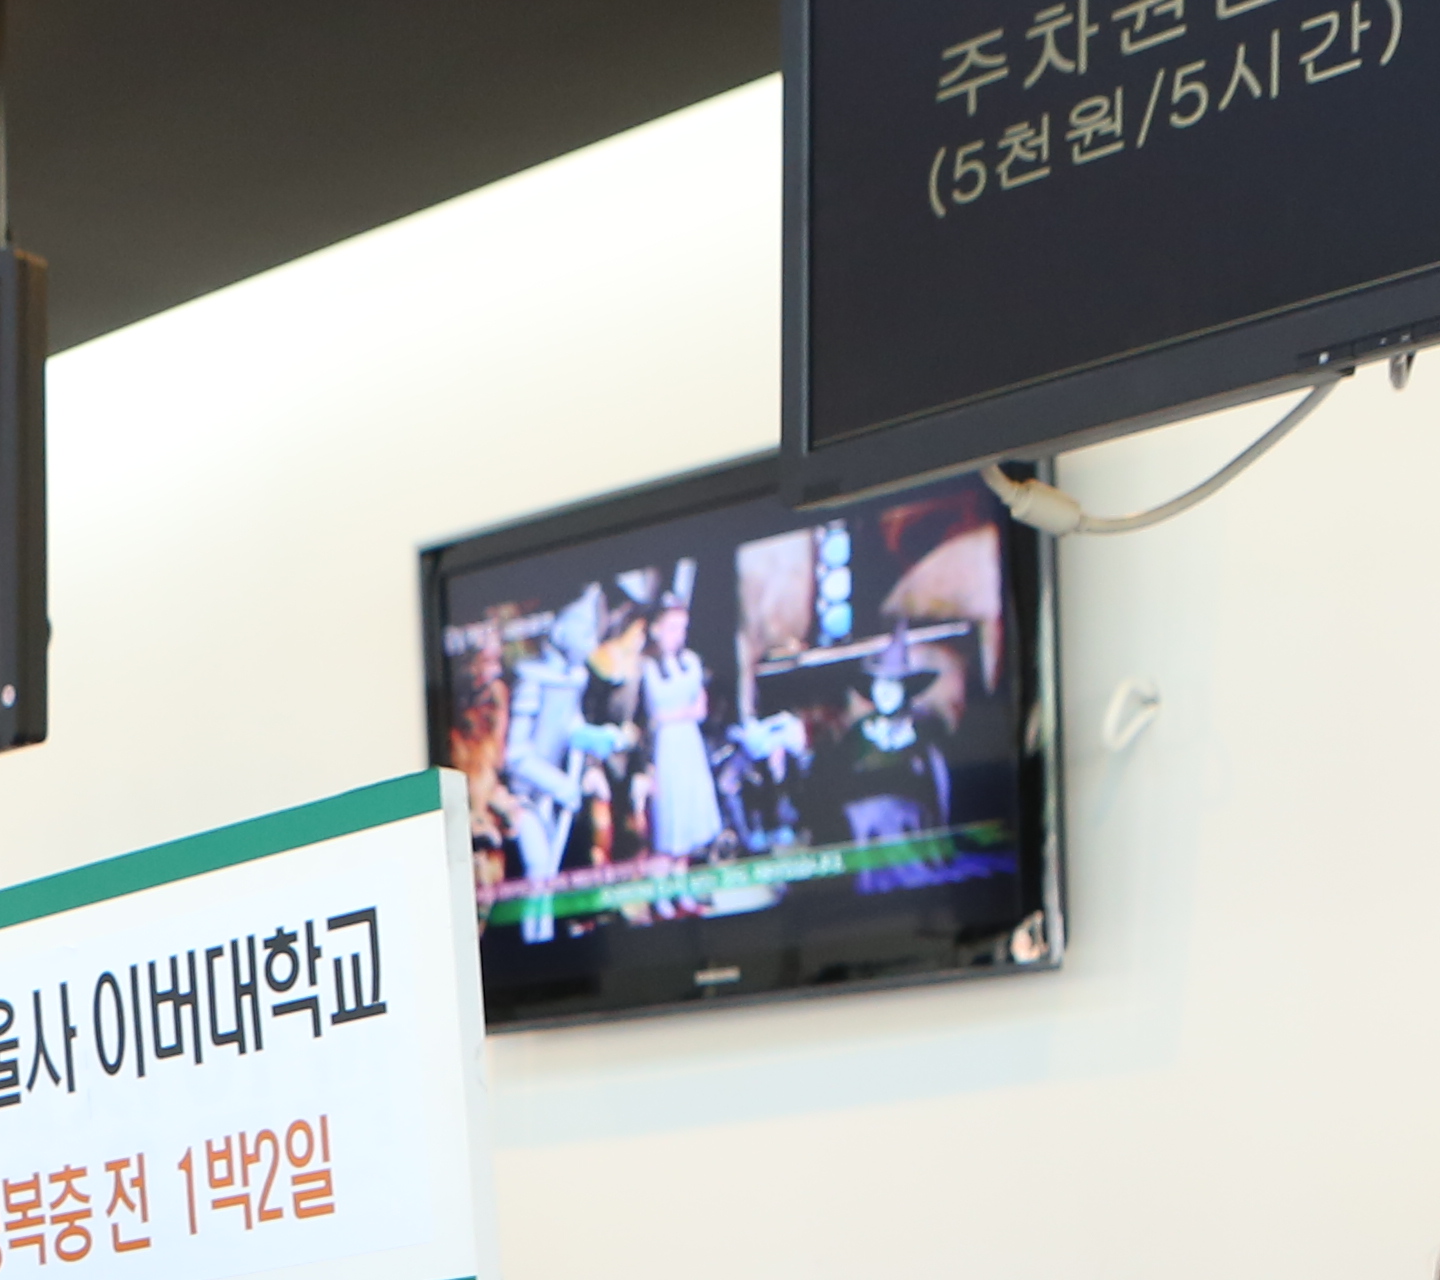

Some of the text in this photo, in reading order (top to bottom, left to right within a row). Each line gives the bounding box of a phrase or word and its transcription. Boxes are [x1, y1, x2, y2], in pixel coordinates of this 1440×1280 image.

[928, 0, 1405, 218] (5천원/5시간)
[935, 0, 1280, 116] 주차권
[176, 1113, 337, 1238] 1박2일
